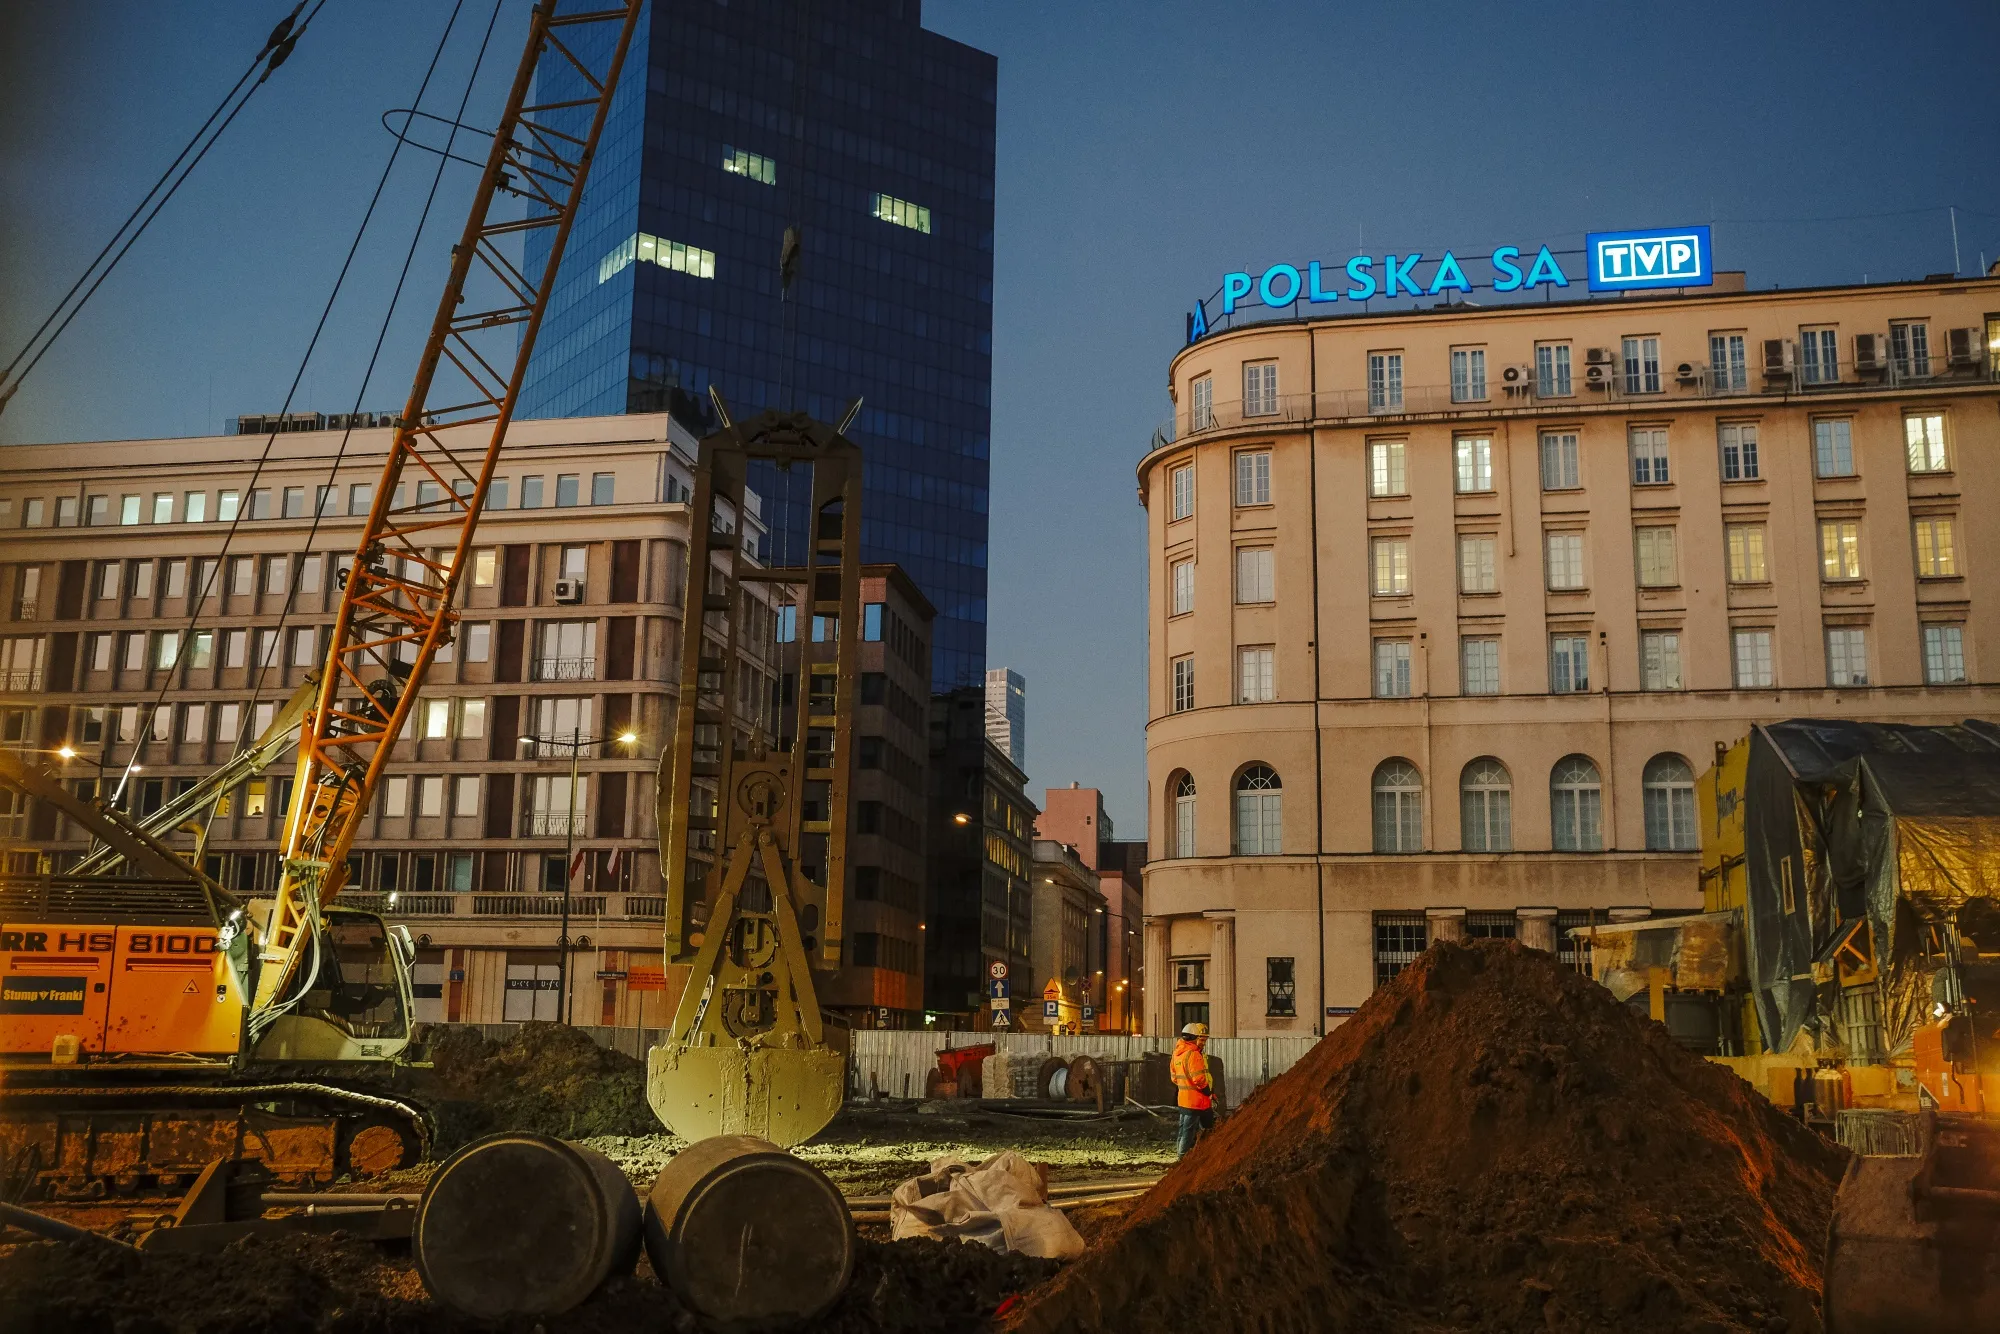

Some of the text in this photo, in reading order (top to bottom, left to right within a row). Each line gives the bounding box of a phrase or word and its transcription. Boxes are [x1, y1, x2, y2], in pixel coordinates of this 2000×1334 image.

[1604, 242, 1691, 277] TVP
[1223, 249, 1473, 314] POLSKA
[1492, 245, 1569, 291] SA
[58, 932, 114, 952] HS
[128, 934, 219, 953] 8100
[992, 966, 1006, 975] 30
[3, 989, 83, 1001] Stump Franki
[880, 1008, 887, 1018] P
[1047, 1002, 1056, 1014] P
[1083, 1007, 1091, 1018] P
